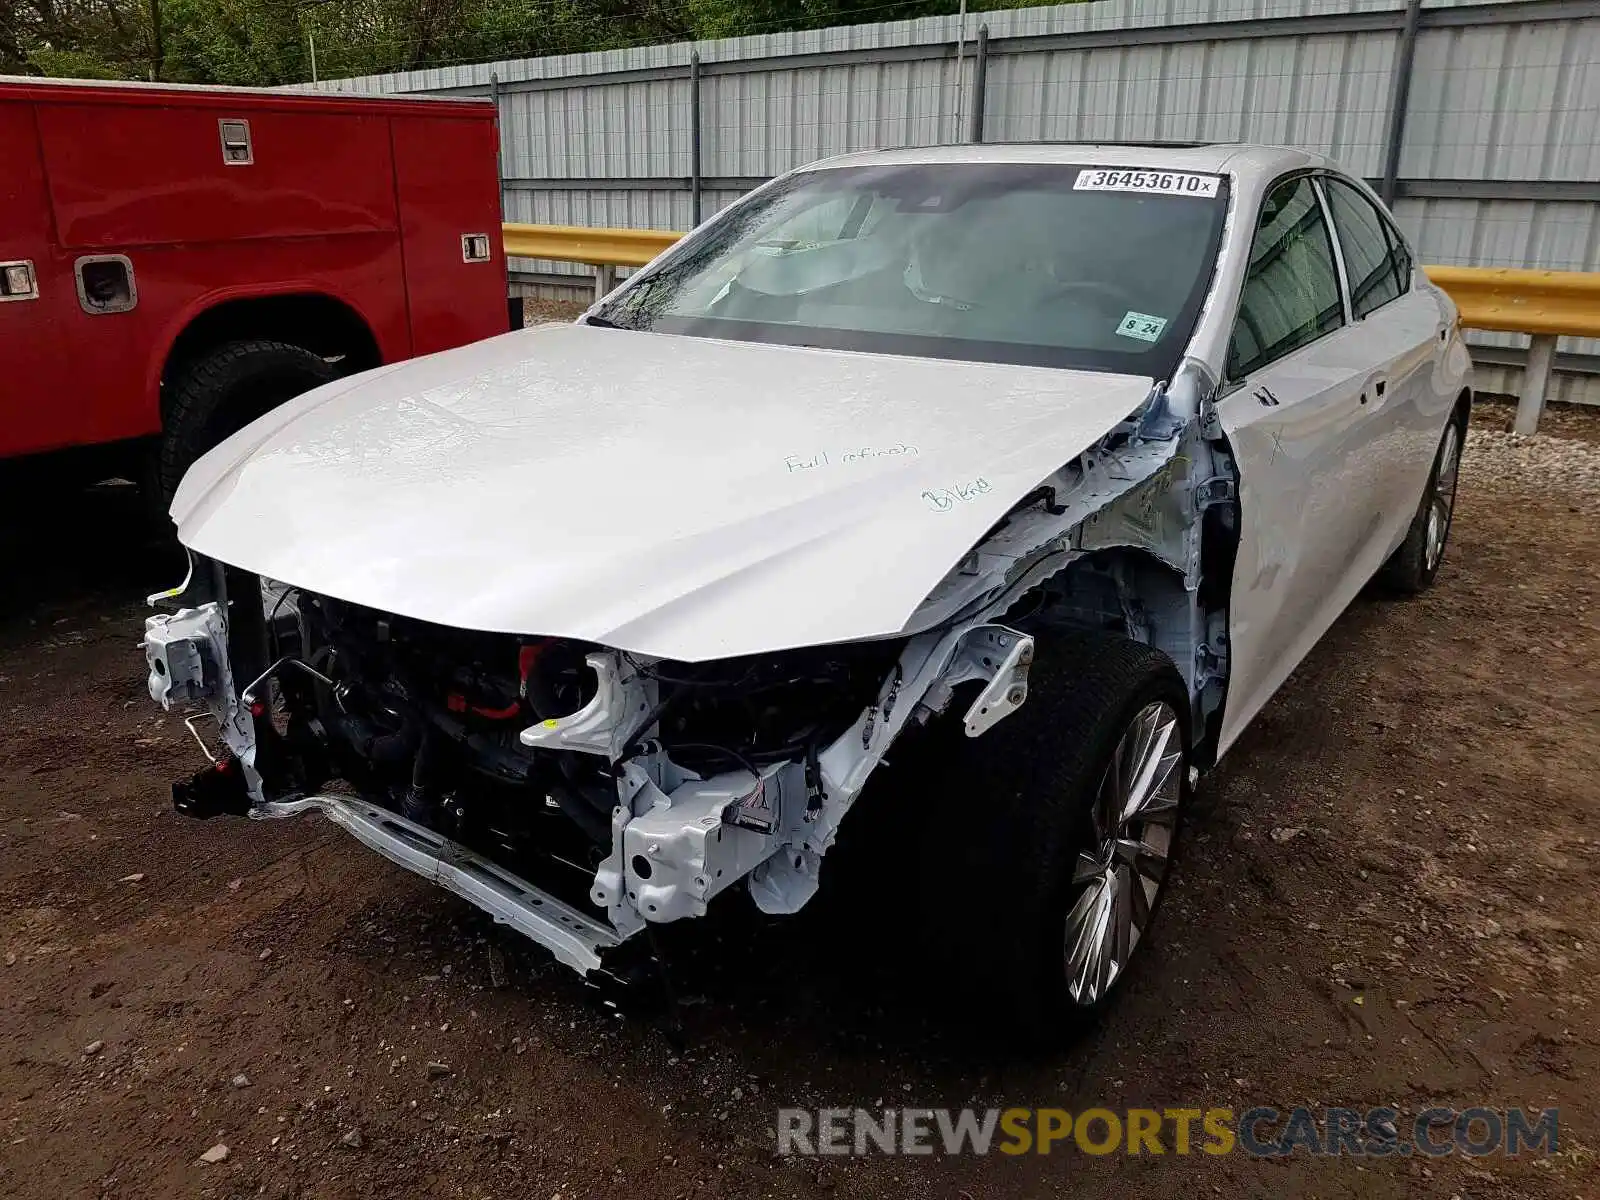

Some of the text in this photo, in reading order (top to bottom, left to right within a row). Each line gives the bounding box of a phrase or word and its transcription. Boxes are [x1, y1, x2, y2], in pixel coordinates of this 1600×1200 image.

[1126, 319, 1136, 330] 8
[1141, 323, 1159, 334] 24
[784, 451, 829, 473] Full
